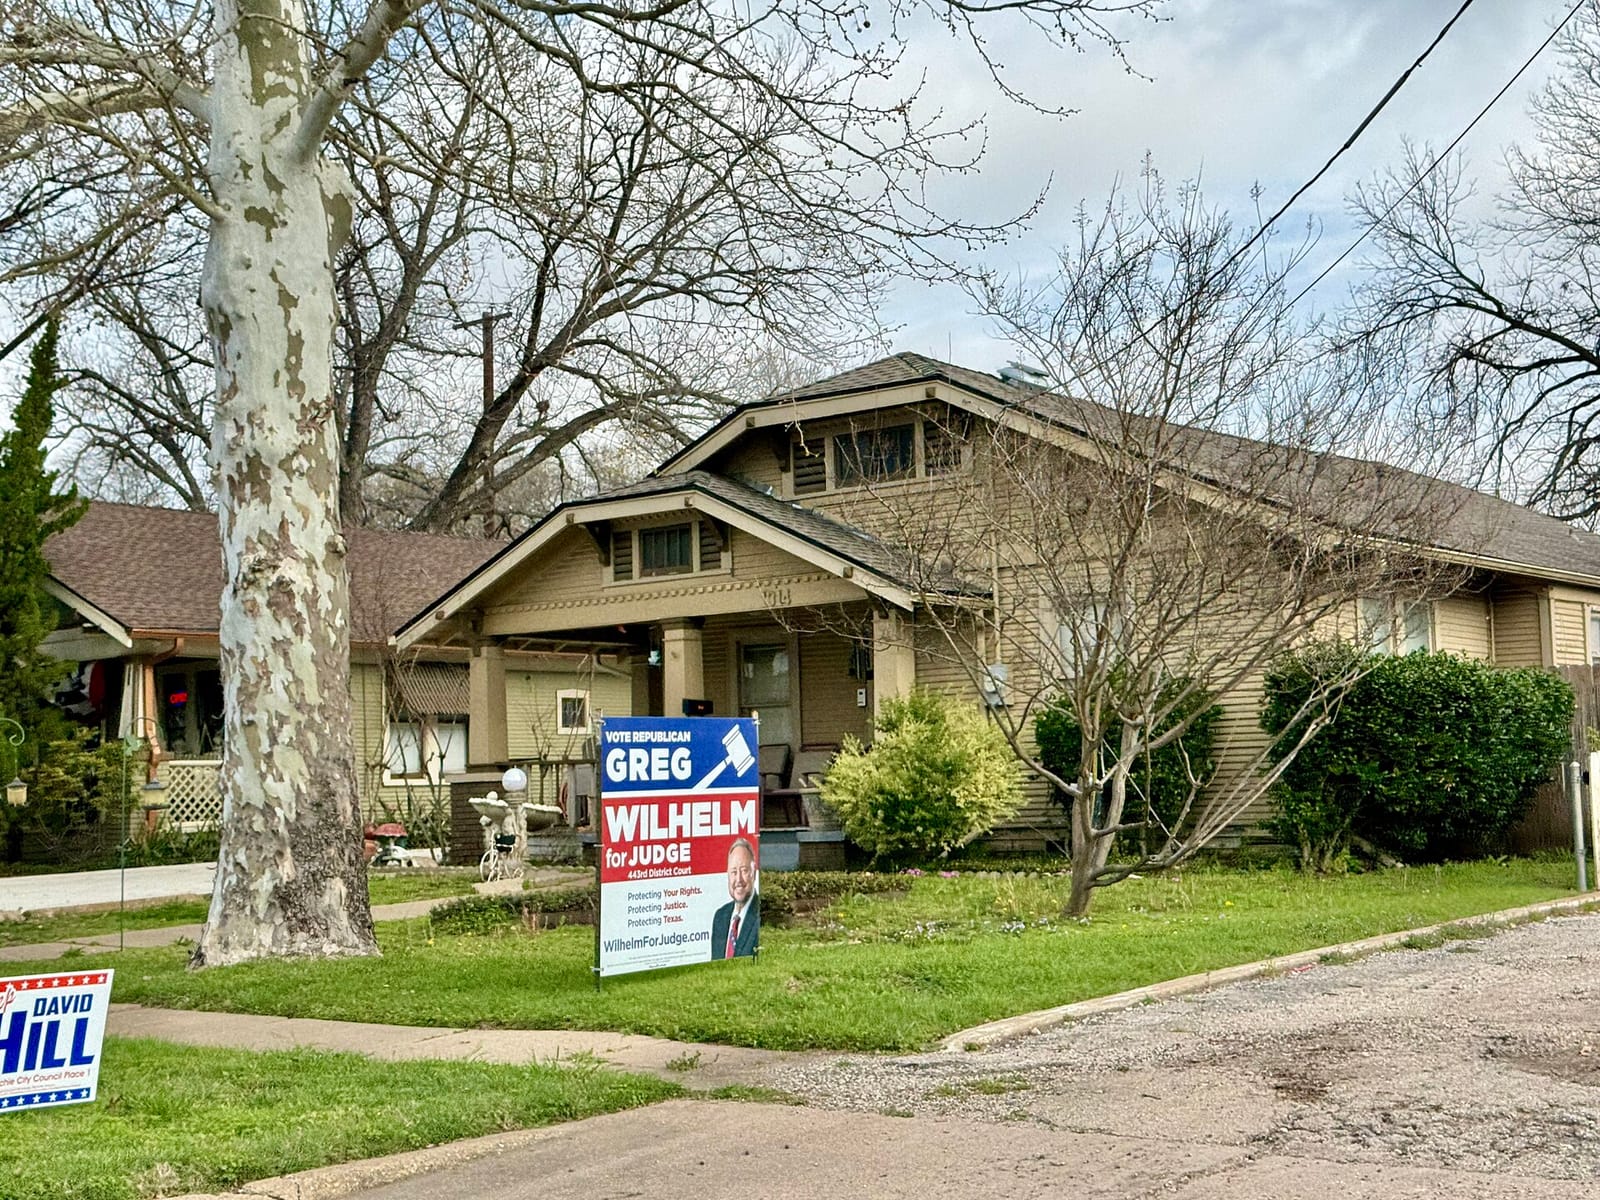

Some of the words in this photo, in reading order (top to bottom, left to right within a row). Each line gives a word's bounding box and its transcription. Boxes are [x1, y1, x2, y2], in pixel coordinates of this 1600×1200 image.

[605, 731, 631, 743] VOTE
[632, 731, 691, 743] REPUBLICAN
[605, 747, 692, 782] GREG
[604, 799, 756, 843] WILHELM
[605, 847, 627, 868] for
[628, 842, 691, 867] JUDGE
[627, 869, 649, 880] 443rd
[649, 867, 672, 878] District
[673, 865, 692, 876] Court
[627, 889, 662, 902] Protecting
[663, 888, 679, 898] Your
[679, 886, 703, 897] Rights.
[627, 903, 662, 915] Protecting
[663, 901, 688, 911] Justice.
[627, 916, 662, 928] Protecting
[663, 915, 684, 924] Texas.
[603, 930, 710, 953] WilhelmForJudge.com
[32, 993, 94, 1018] DAVID
[0, 1010, 95, 1075] HILL
[16, 1075, 32, 1085] City
[33, 1070, 63, 1083] Council
[63, 1069, 86, 1080] Place
